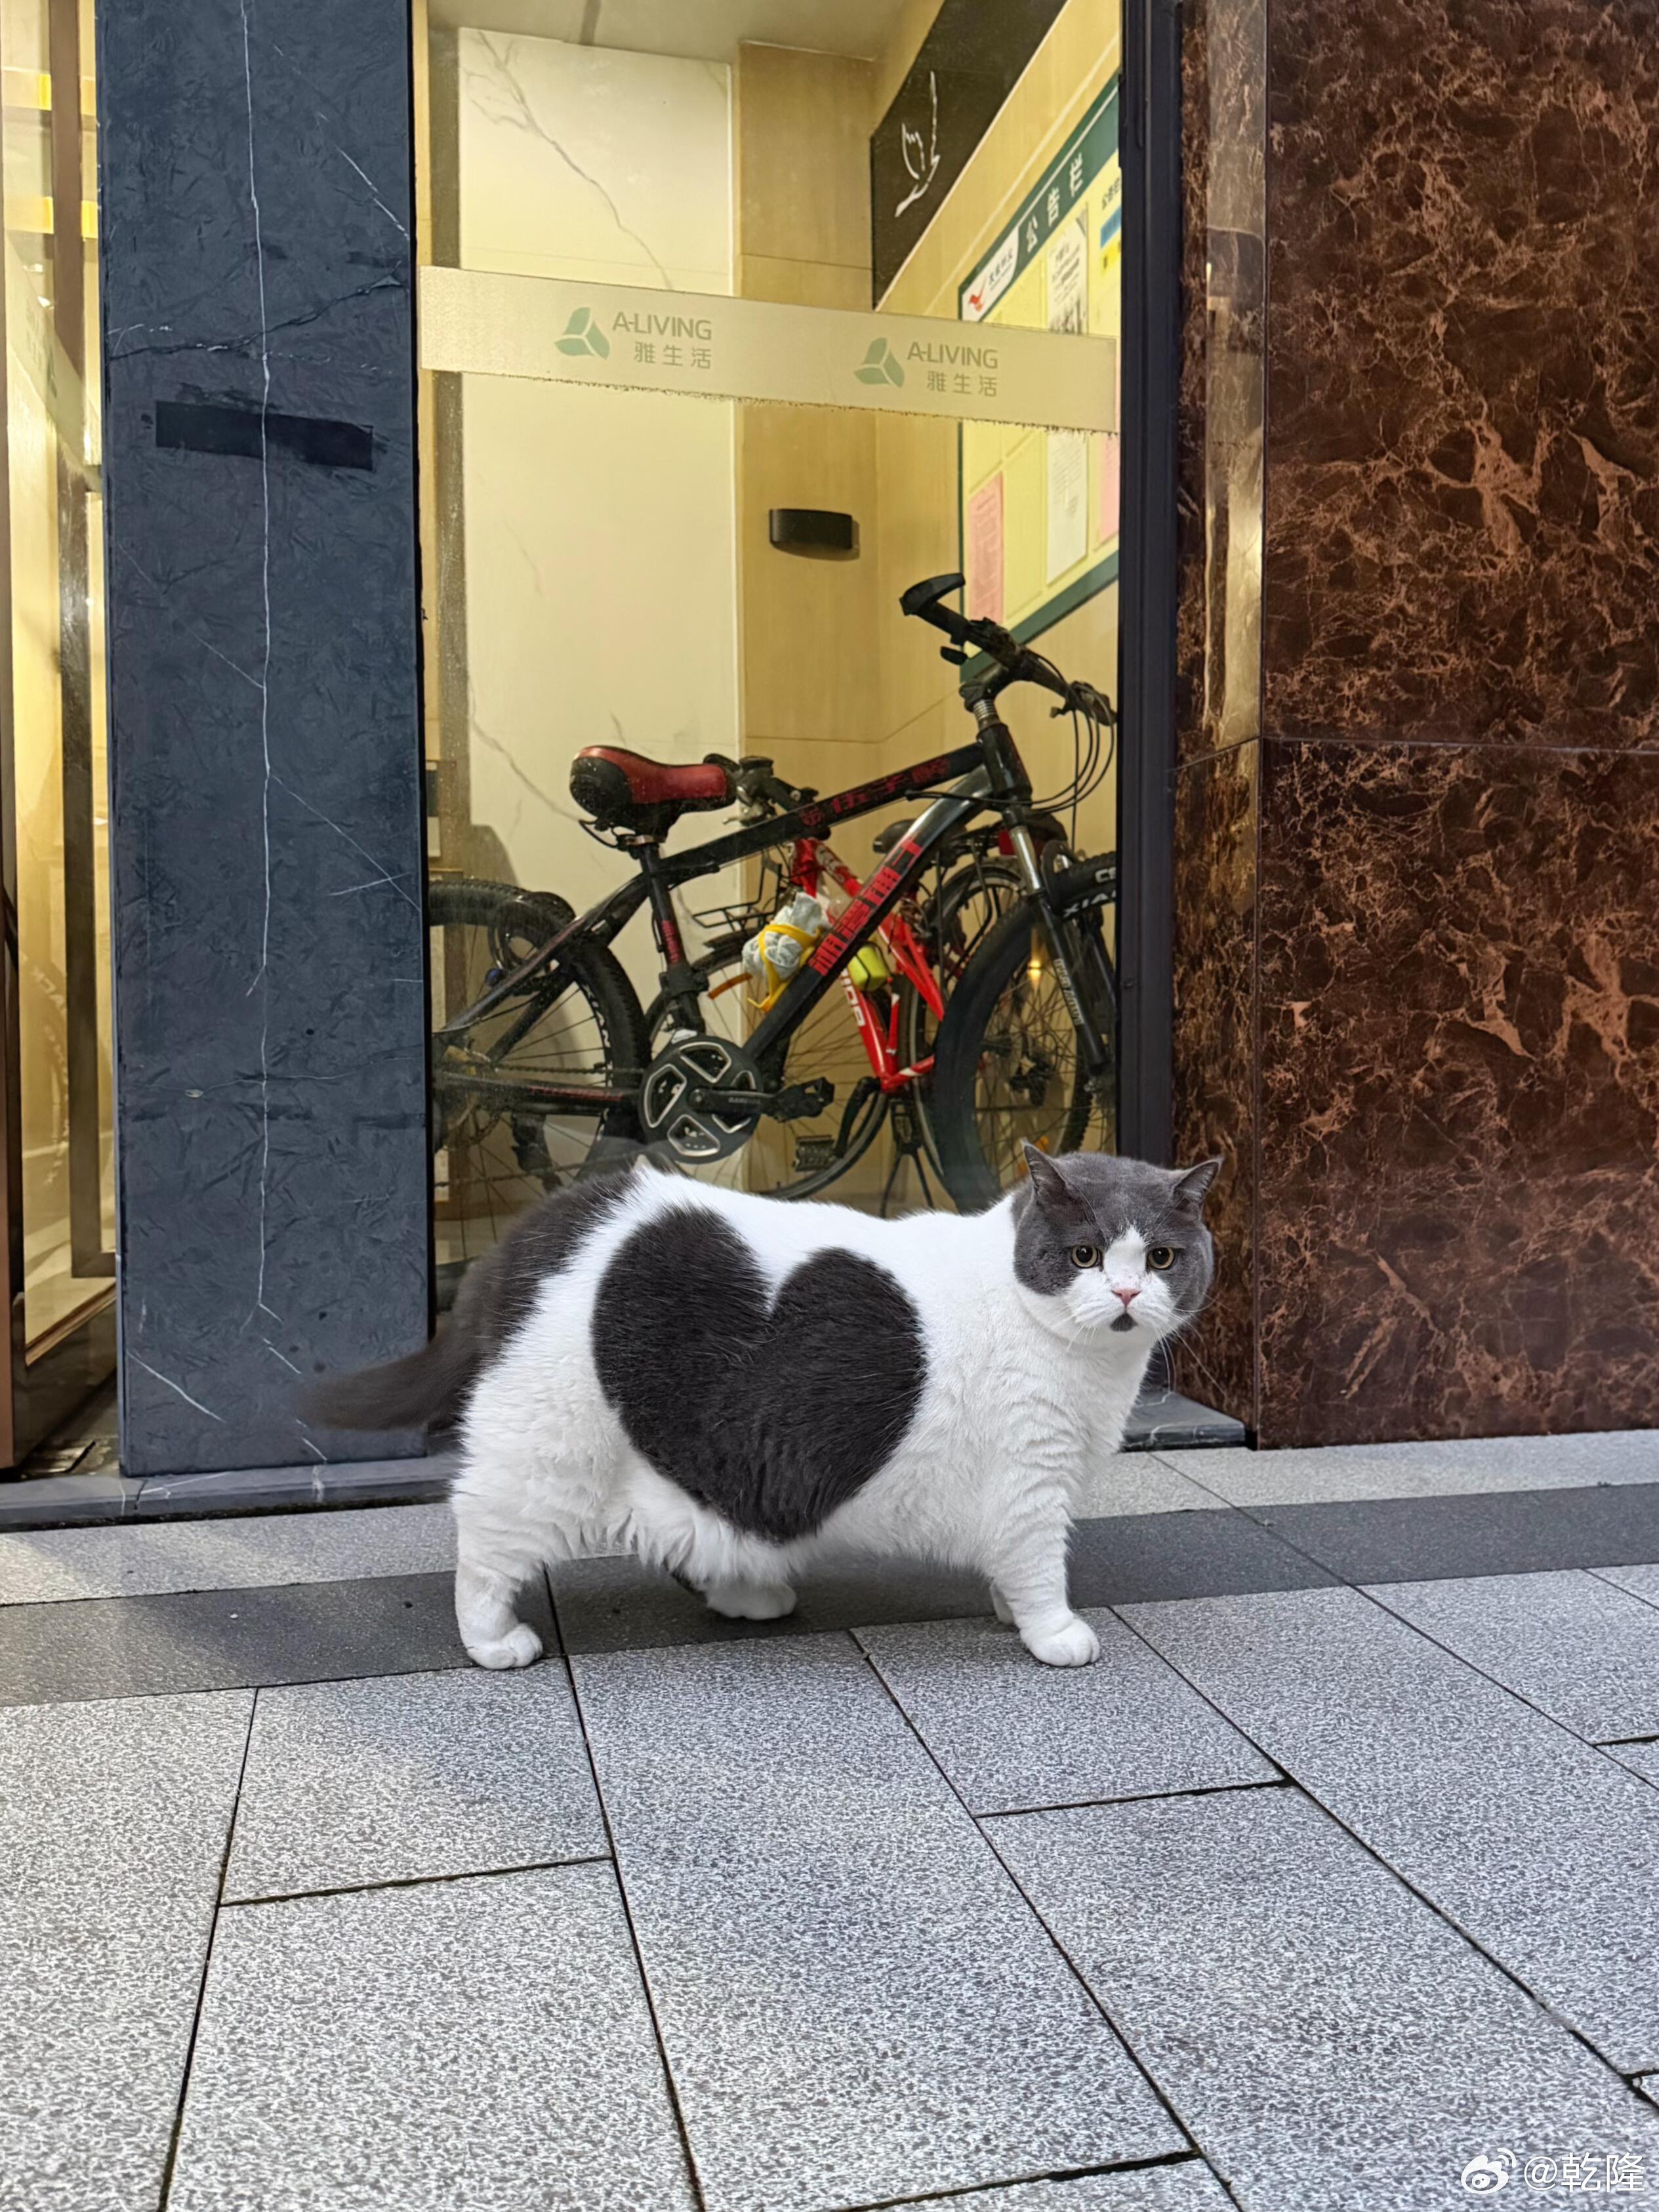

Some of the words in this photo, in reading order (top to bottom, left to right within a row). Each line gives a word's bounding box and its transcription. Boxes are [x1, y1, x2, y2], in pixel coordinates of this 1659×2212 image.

[612, 311, 712, 340] A-LIVING
[634, 341, 712, 369] 雅生活
[906, 341, 998, 369] A-LIVING
[926, 370, 998, 397] 雅生活
